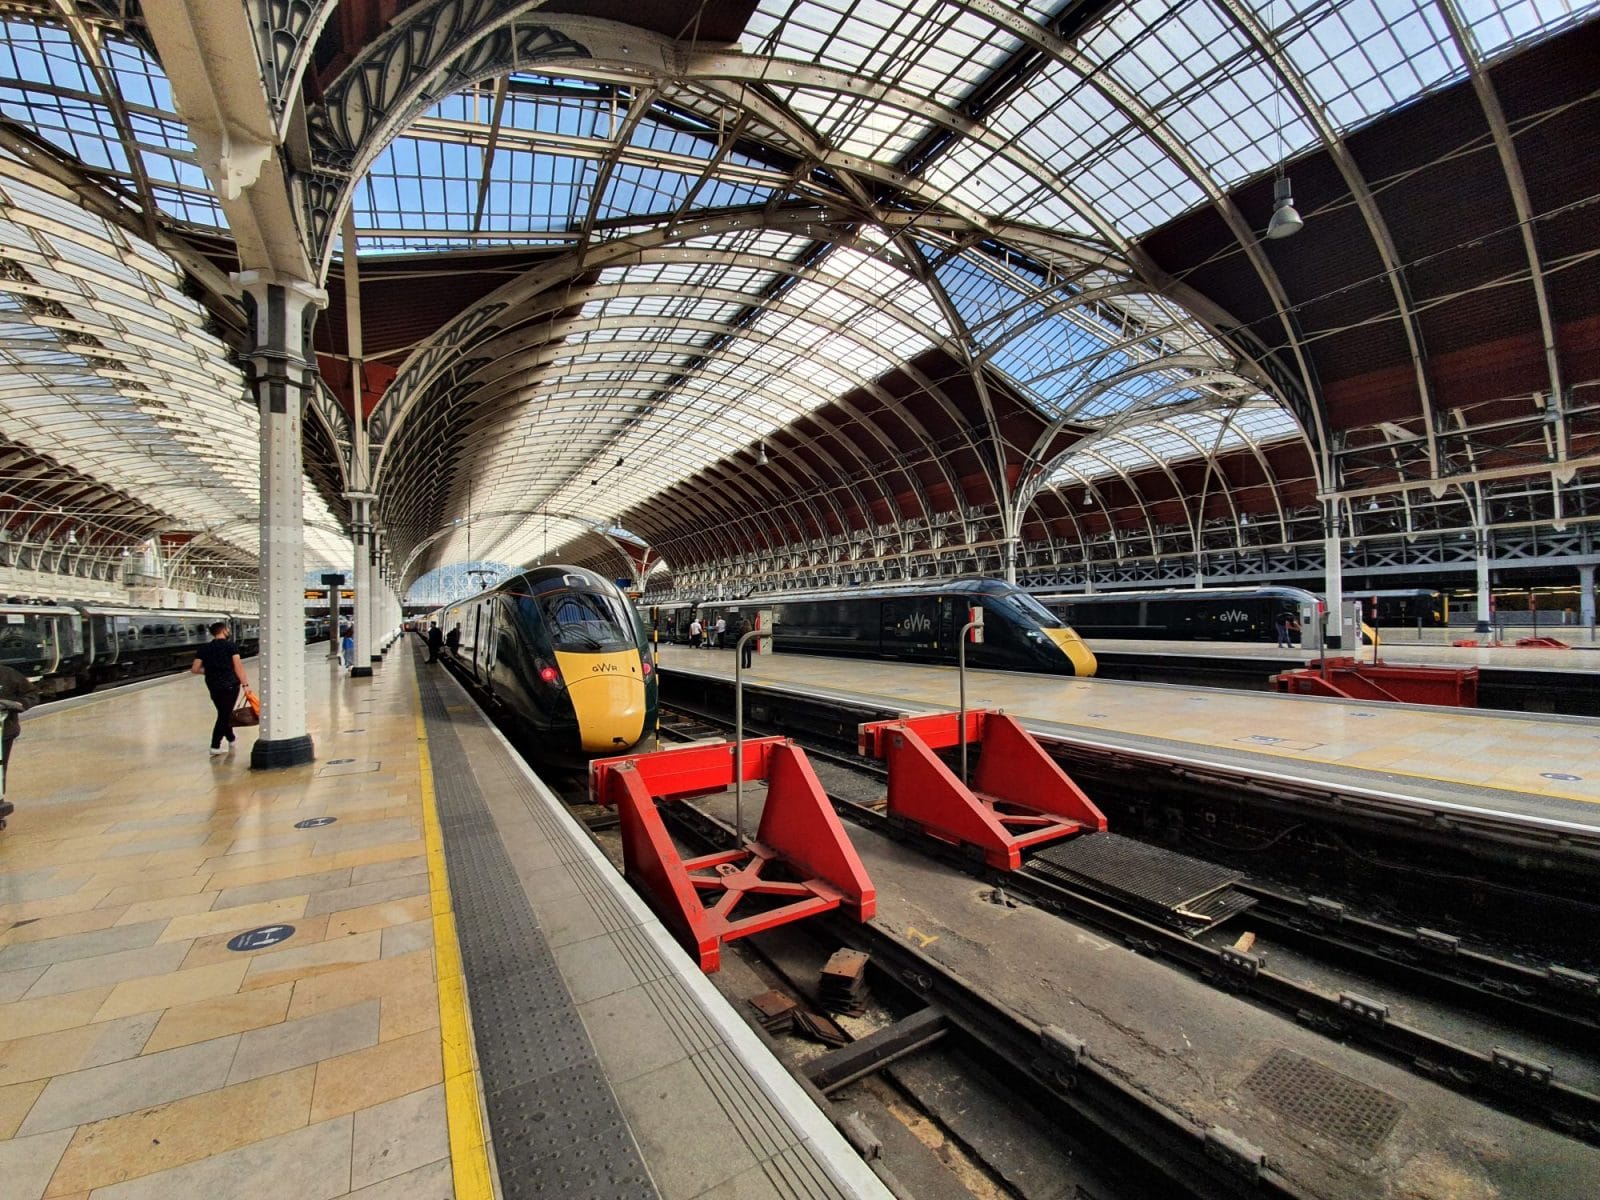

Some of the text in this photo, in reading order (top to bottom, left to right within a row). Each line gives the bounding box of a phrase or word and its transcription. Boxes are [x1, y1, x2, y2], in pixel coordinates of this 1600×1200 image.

[903, 611, 931, 632] GWR
[1220, 609, 1249, 623] GWR
[592, 662, 618, 672] GWR
